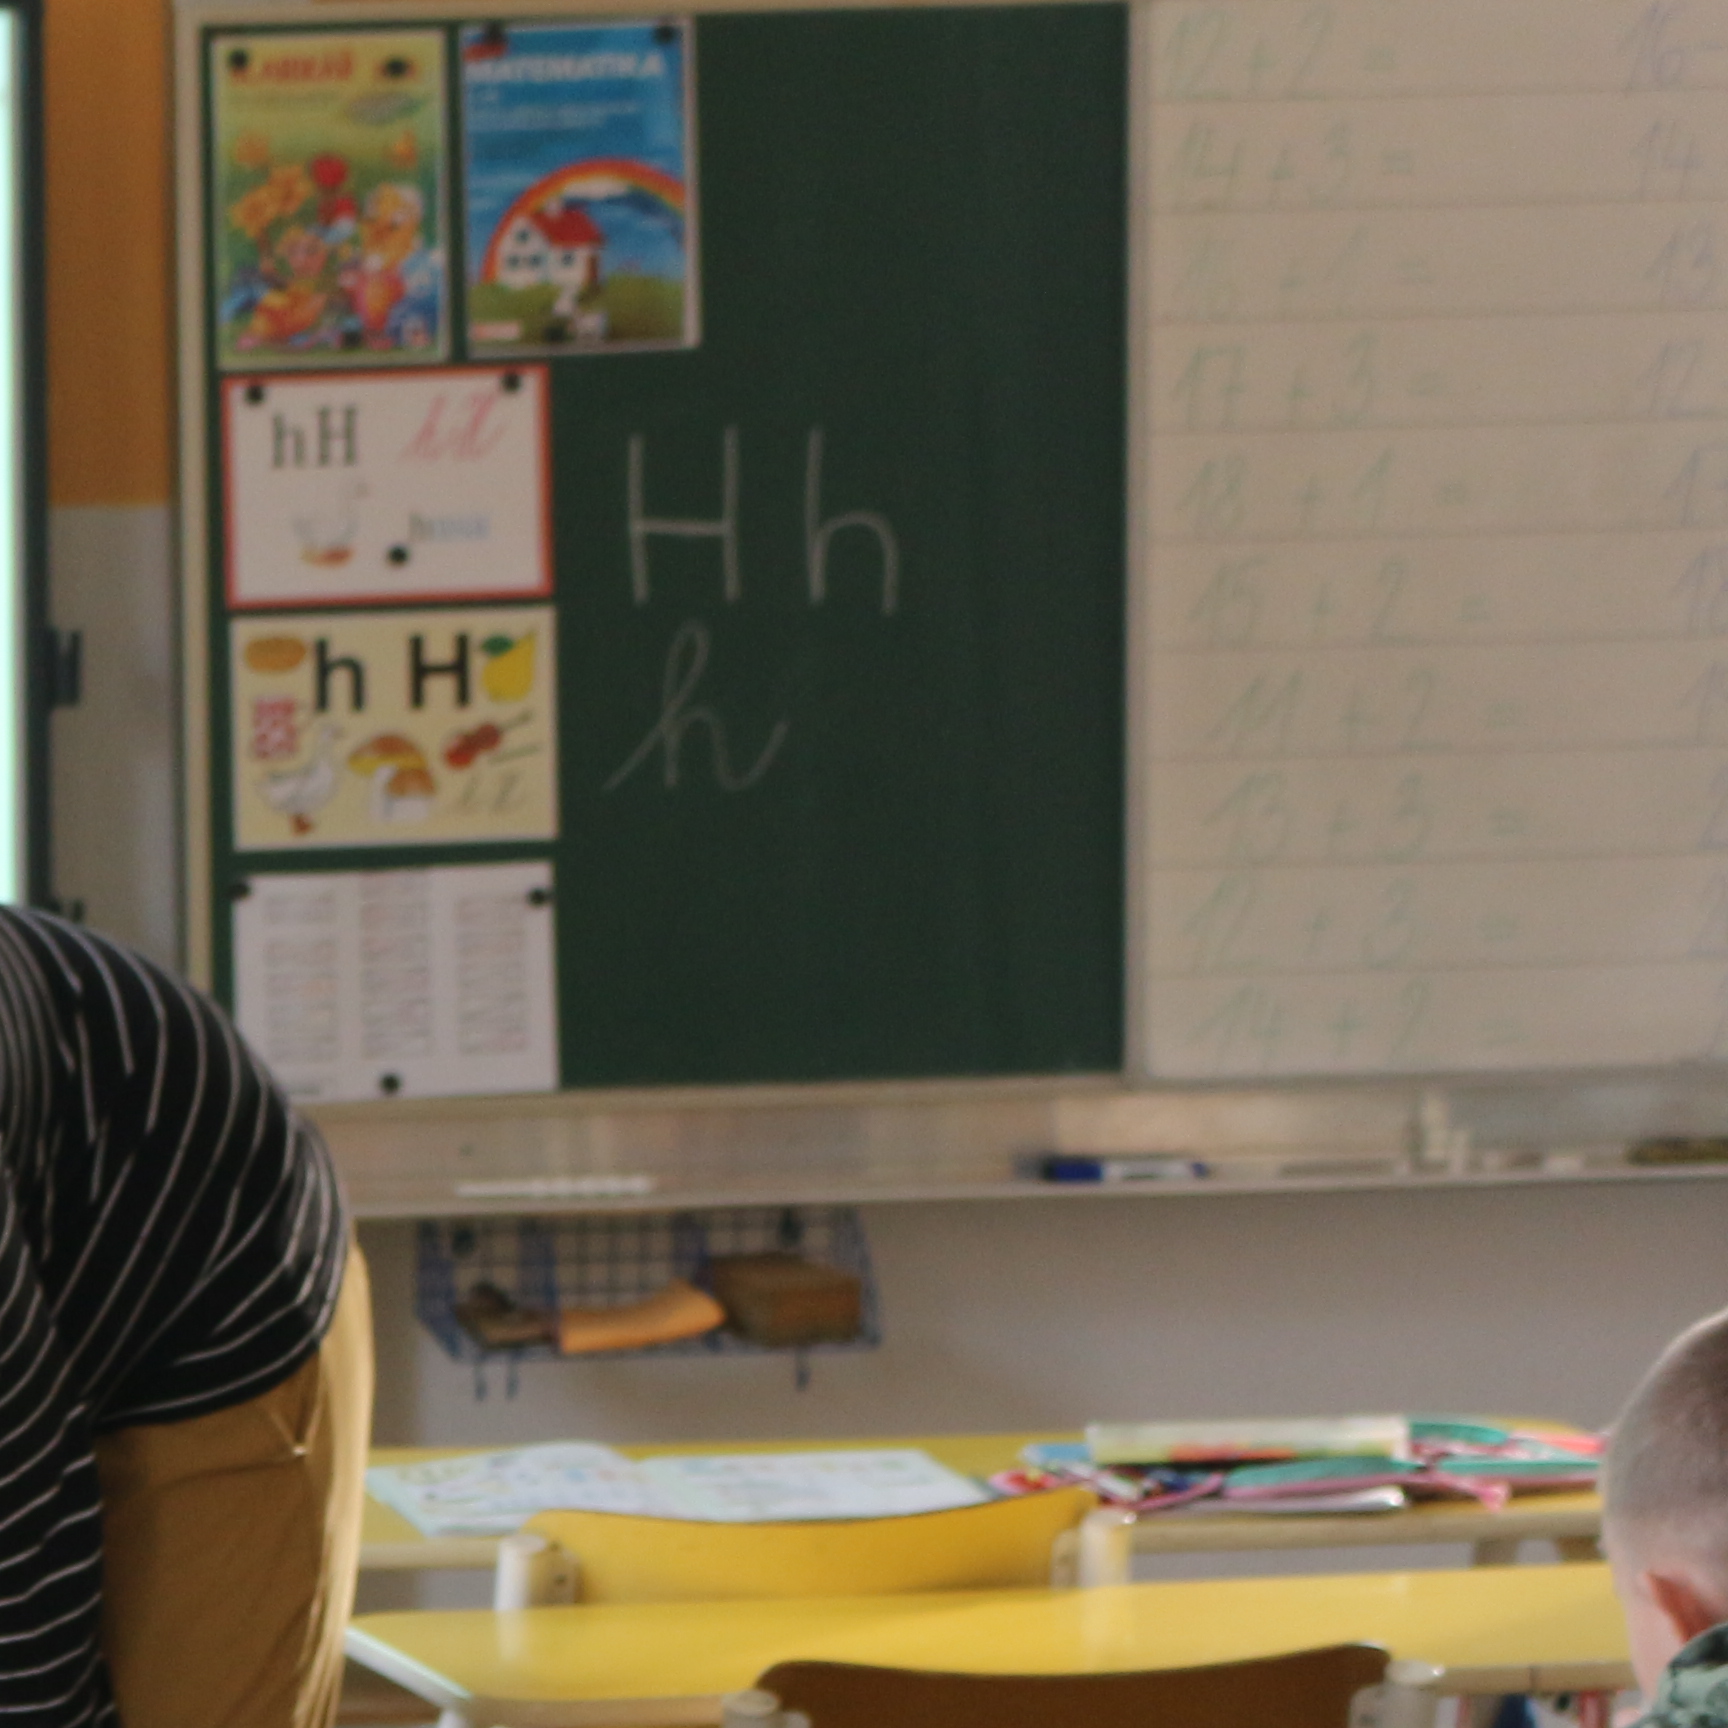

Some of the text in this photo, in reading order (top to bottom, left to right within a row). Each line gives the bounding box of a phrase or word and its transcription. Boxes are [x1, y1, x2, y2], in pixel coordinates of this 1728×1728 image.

[627, 424, 900, 616] H h
[315, 630, 472, 712] h H
[600, 616, 791, 792] h
